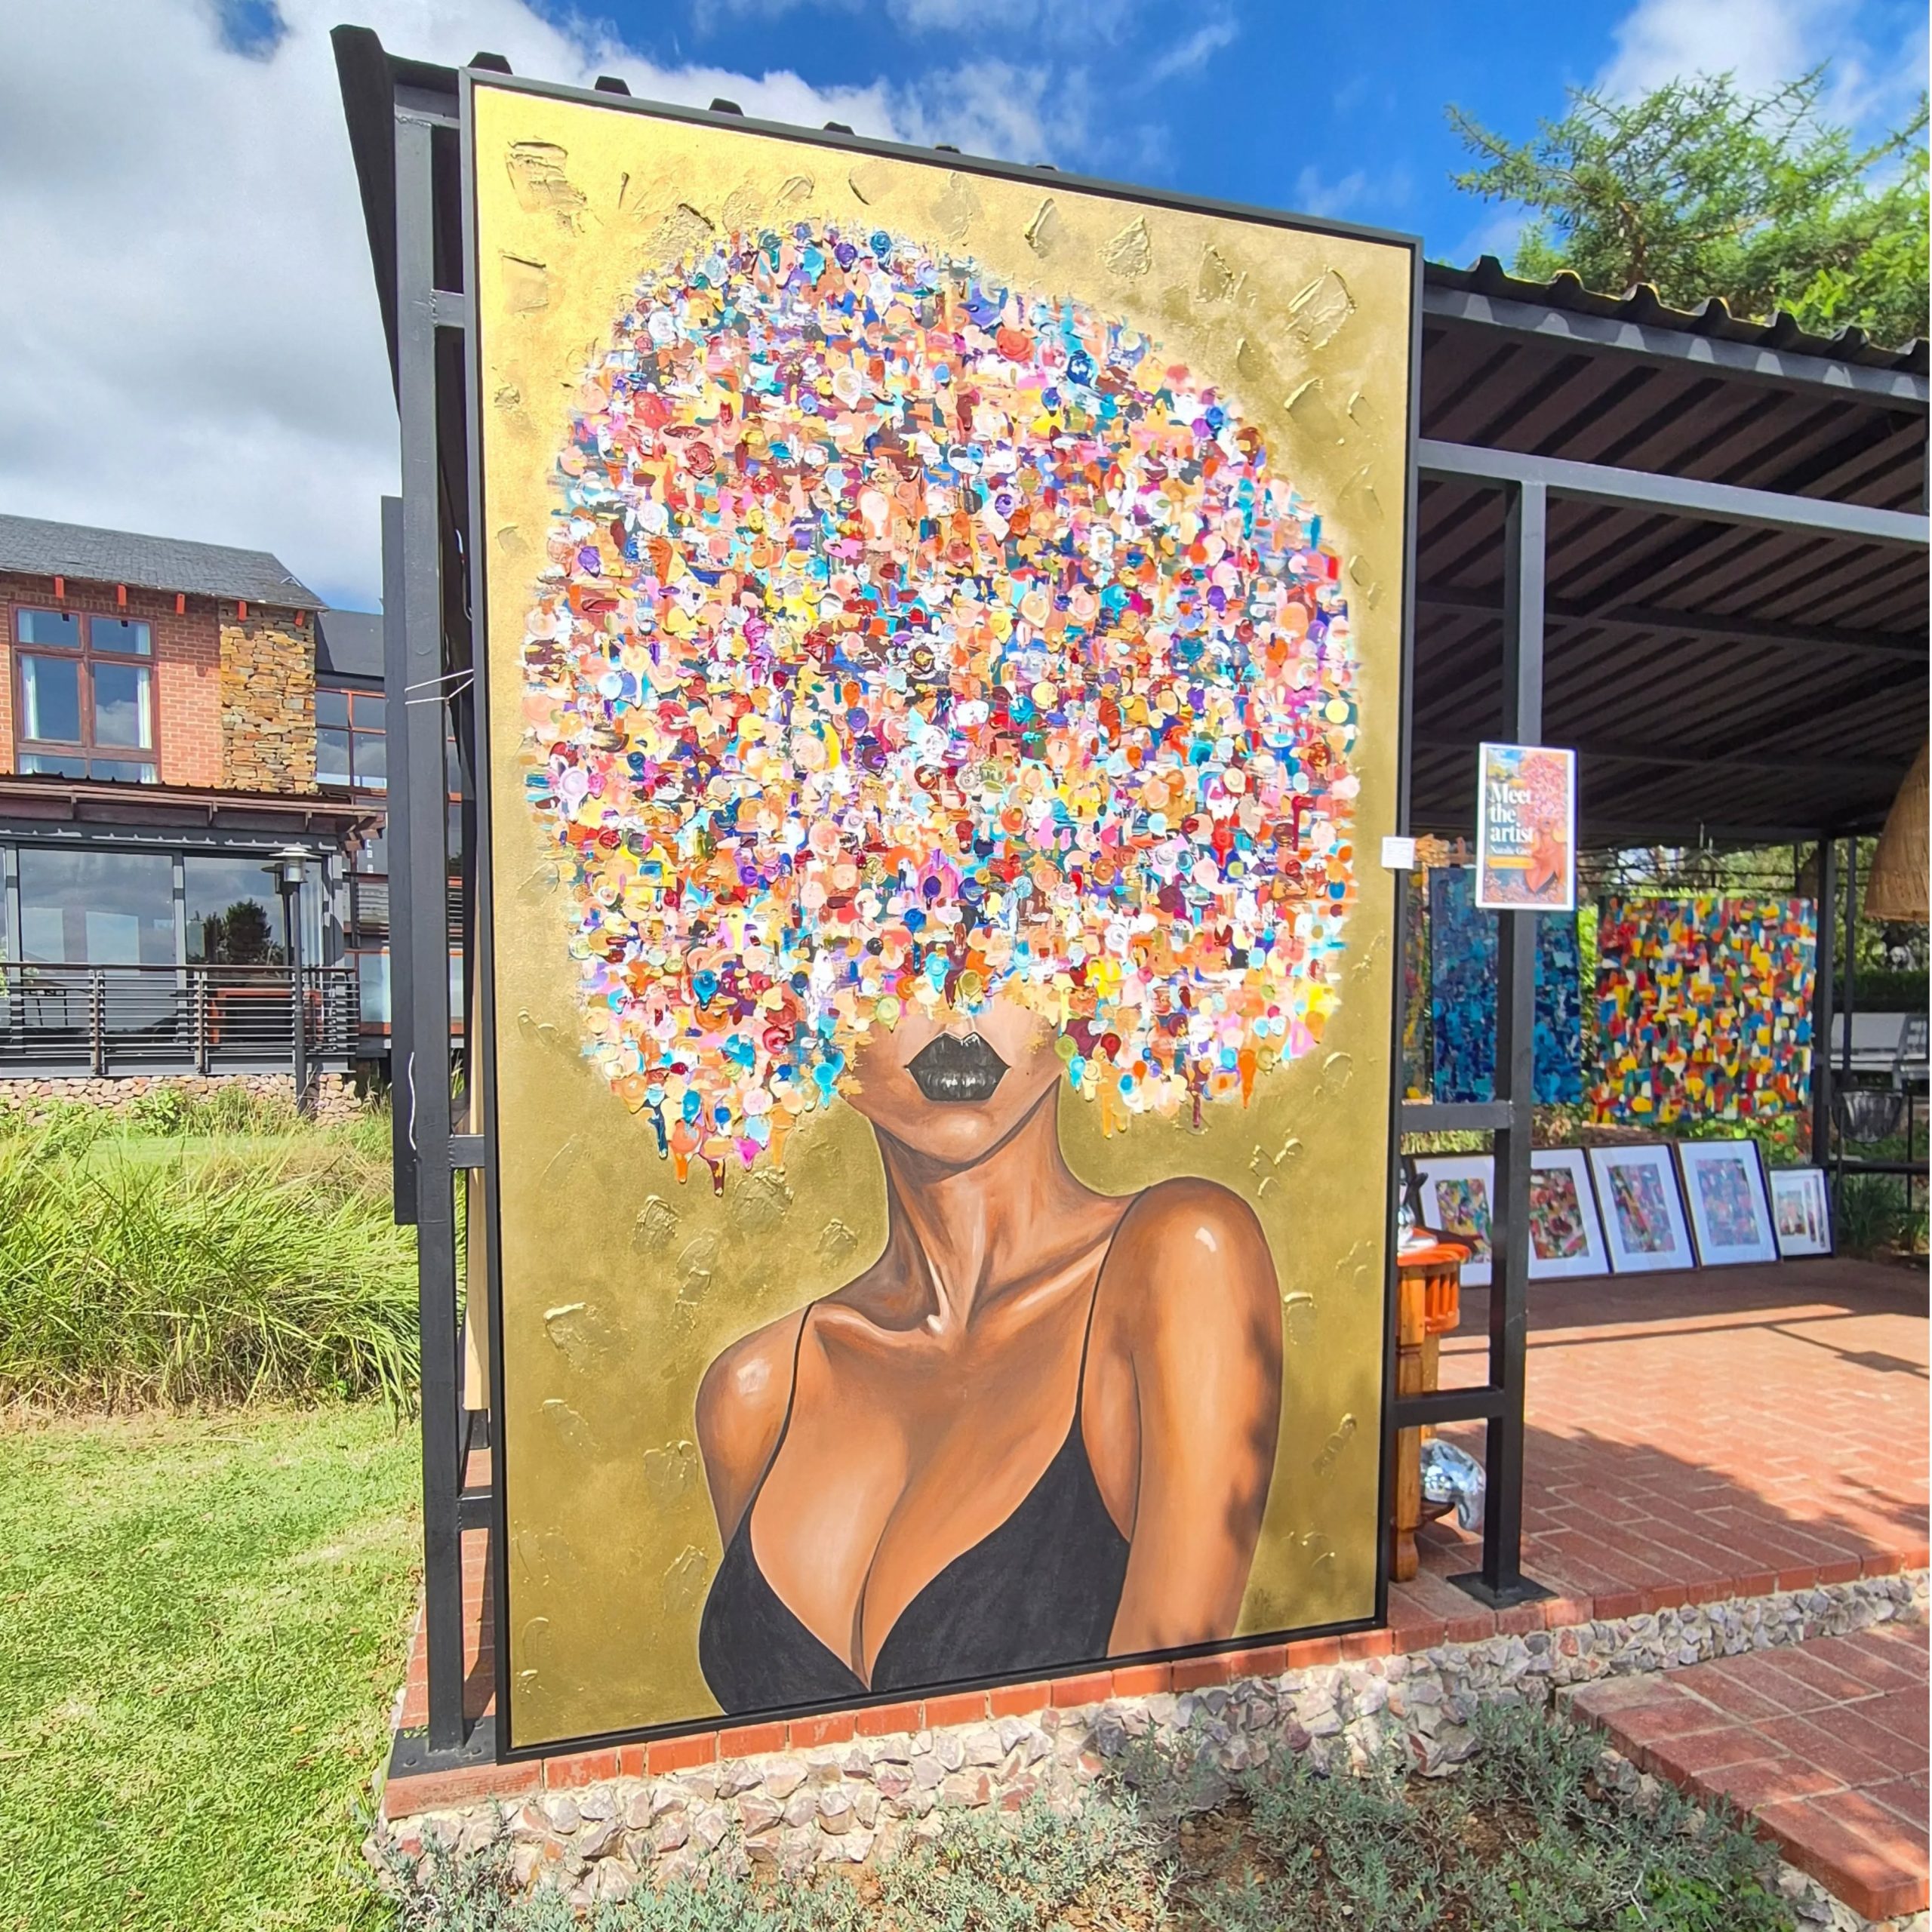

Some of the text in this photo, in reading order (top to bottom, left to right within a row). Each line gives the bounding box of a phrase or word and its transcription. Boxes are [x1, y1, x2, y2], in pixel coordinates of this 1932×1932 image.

[1490, 783, 1531, 804] Meet
[1490, 803, 1516, 823] the
[1490, 822, 1534, 843] artist
